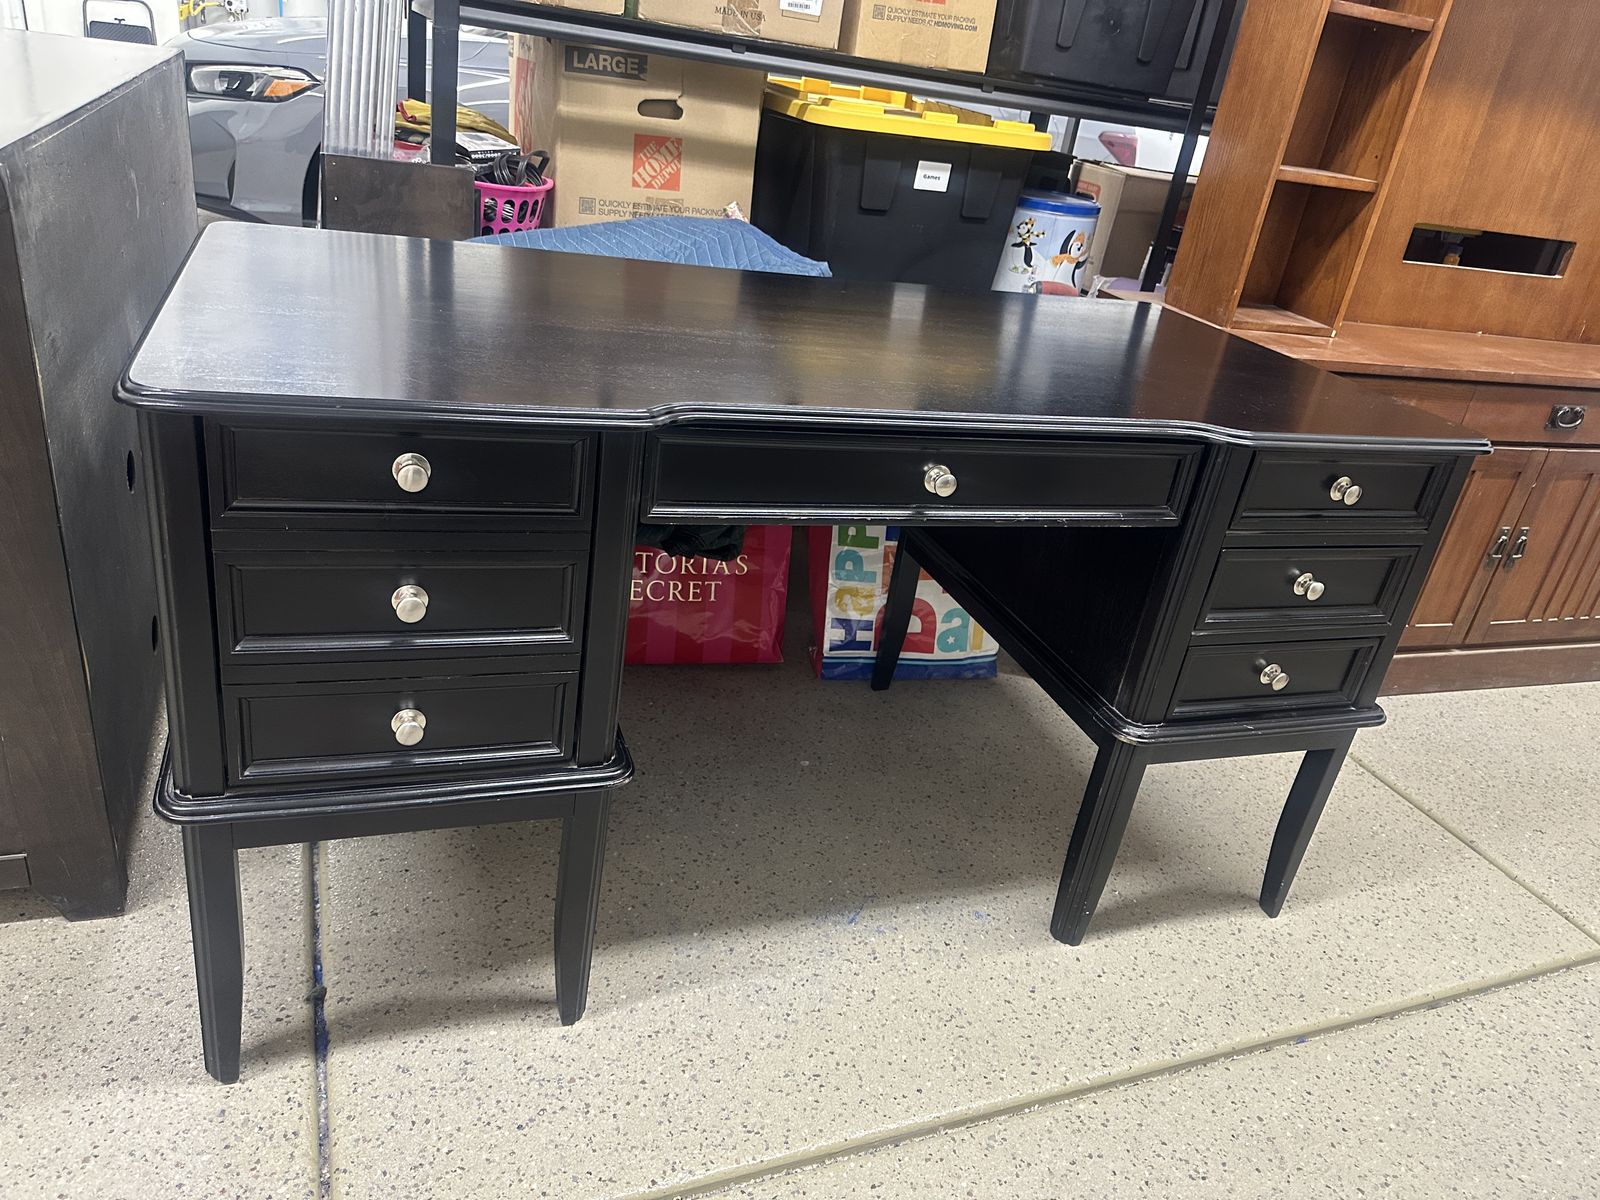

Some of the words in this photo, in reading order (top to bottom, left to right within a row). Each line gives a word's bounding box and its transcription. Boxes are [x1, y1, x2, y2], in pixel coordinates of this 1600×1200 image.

[714, 6, 738, 17] MADE
[741, 10, 748, 19] IN
[750, 11, 766, 21] USA
[886, 14, 908, 23] SUPPLY
[908, 17, 927, 26] NEEDS
[927, 19, 934, 27] AT
[934, 20, 978, 32] HDMOVING.COM
[887, 6, 911, 16] QUICKLY
[911, 9, 937, 20] ESTIMATE
[937, 13, 953, 21] YOUR
[953, 16, 976, 24] PACKING
[573, 50, 639, 75] LARGE
[639, 140, 659, 161] THE
[632, 138, 681, 188] HOME
[651, 158, 681, 189] DEPOT
[923, 173, 941, 181] Games
[598, 199, 631, 209] QUICKLY
[669, 205, 690, 214] YOUR
[691, 207, 724, 217] PACKING
[598, 207, 628, 218] SUPPLY
[635, 551, 748, 576] TORIAS
[630, 579, 722, 602] ECRET
